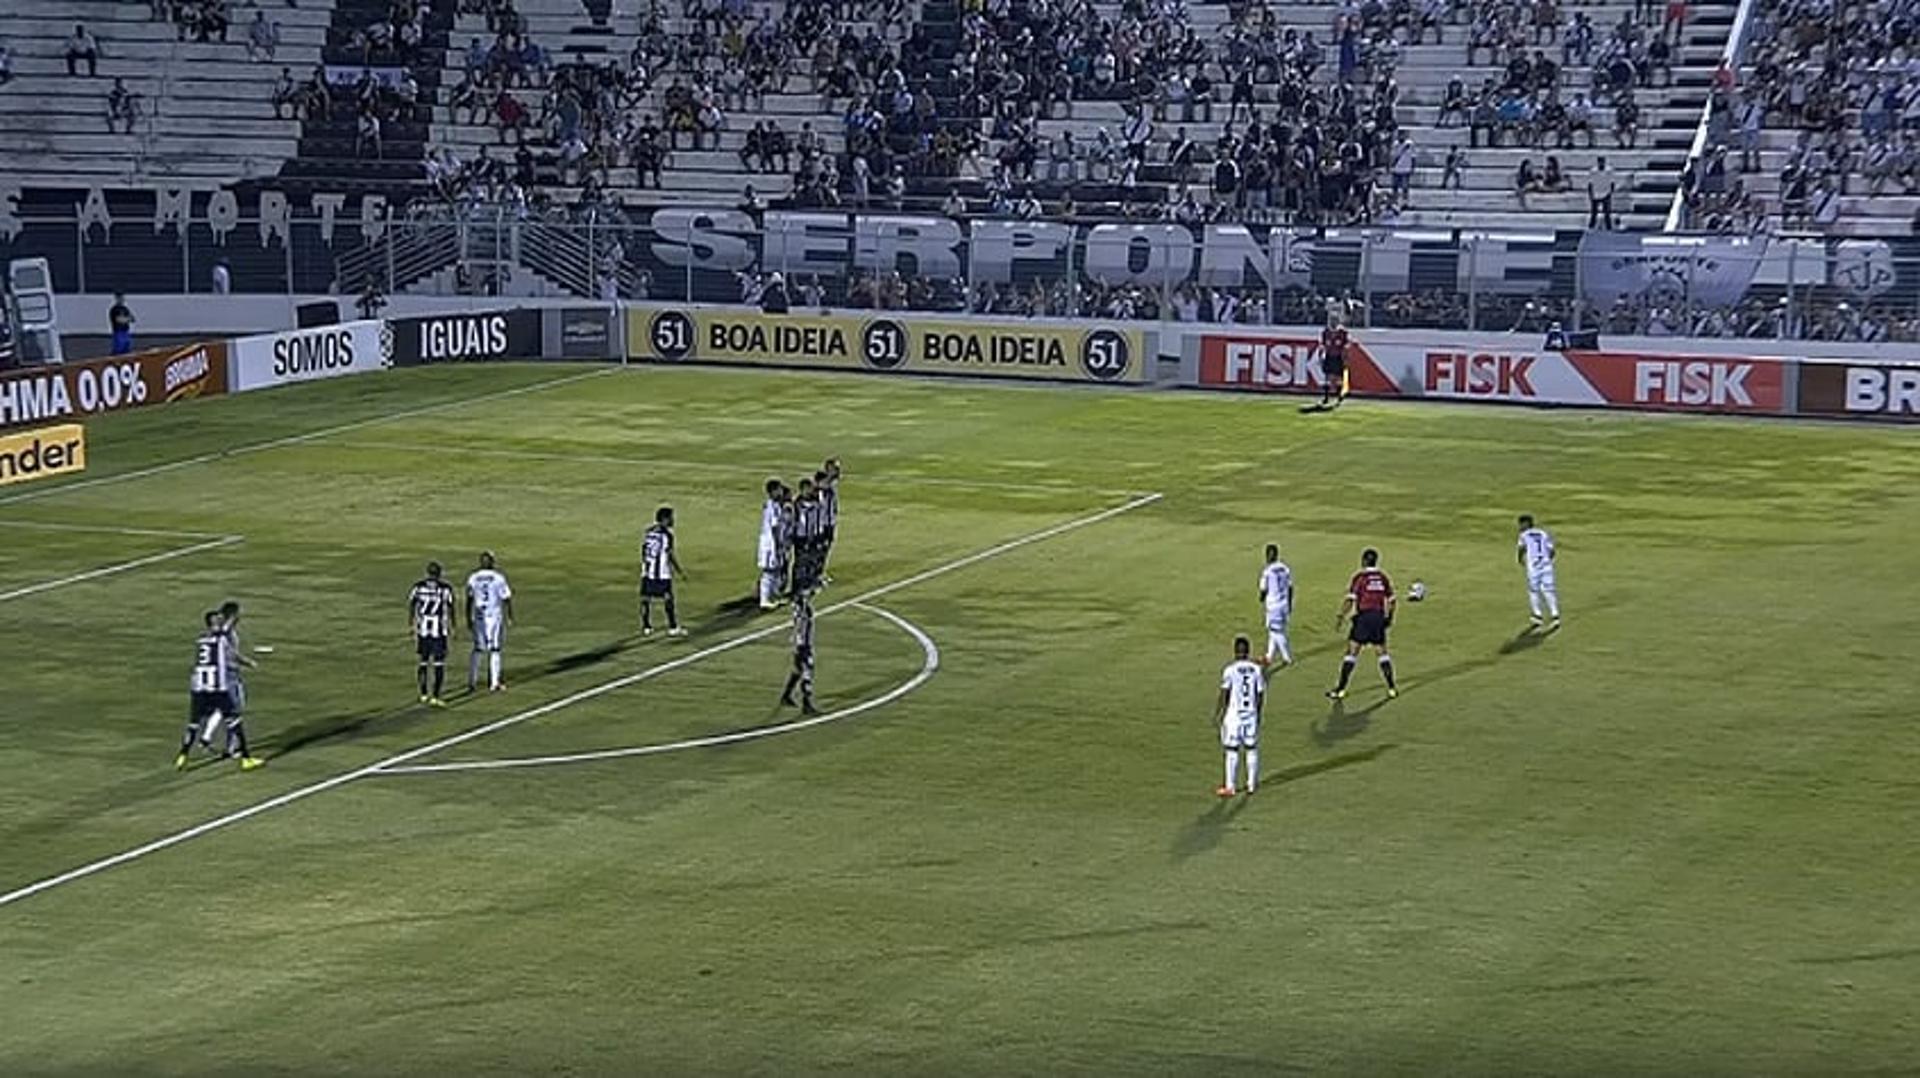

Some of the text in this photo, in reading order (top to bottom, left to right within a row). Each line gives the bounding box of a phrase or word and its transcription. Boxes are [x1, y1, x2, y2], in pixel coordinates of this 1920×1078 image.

[78, 187, 112, 244] A
[154, 188, 386, 248] MORTE
[273, 331, 352, 375] SOMOS
[420, 316, 507, 358] IGUAIS
[658, 320, 1121, 368] 51 BOA IDEIA 51 BOA IDEIA 51
[1225, 343, 1326, 386] FISK
[1425, 353, 1536, 396] FISK
[1634, 362, 1752, 406] FISK
[78, 362, 146, 412] 0,0%
[1845, 368, 1920, 418] BR
[419, 595, 441, 613] 77
[199, 644, 211, 664] 3
[1242, 675, 1250, 698] 5
